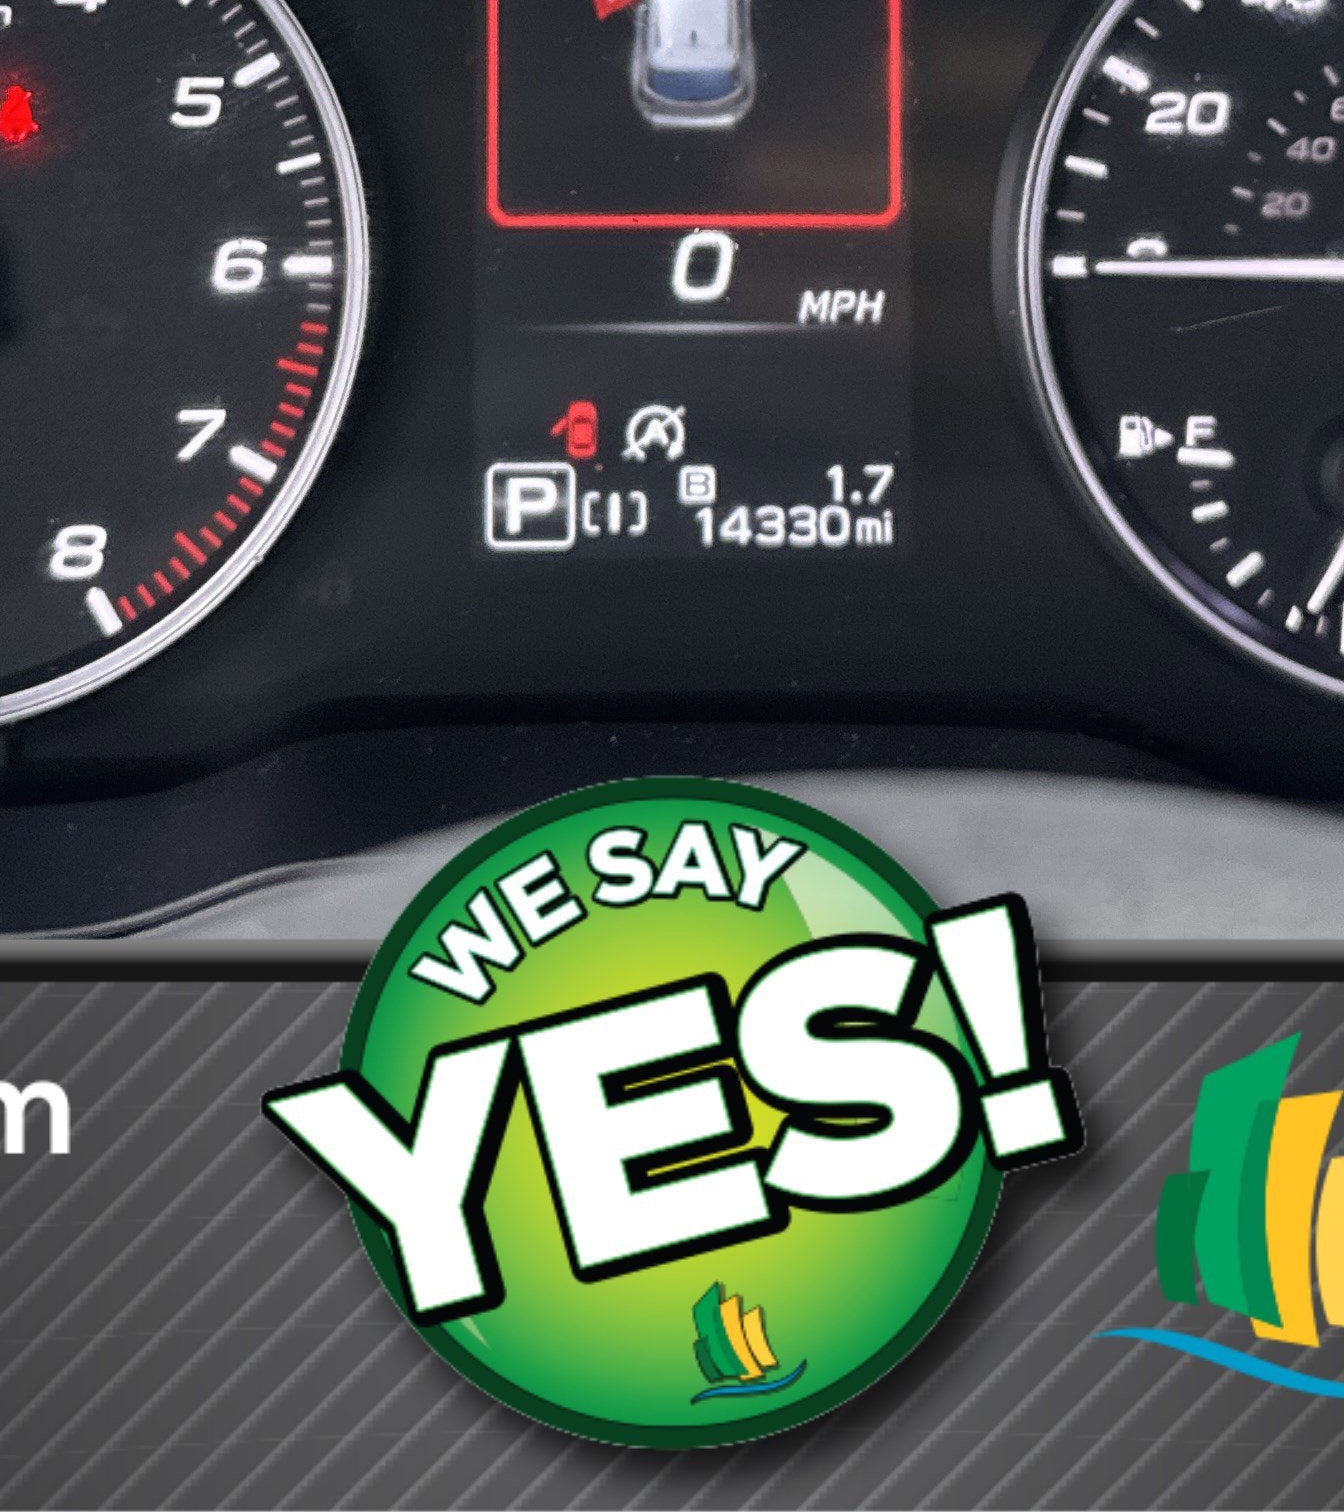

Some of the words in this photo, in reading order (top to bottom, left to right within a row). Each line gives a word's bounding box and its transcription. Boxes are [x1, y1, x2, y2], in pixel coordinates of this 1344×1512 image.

[170, 77, 224, 128] 5
[1145, 91, 1230, 135] 20
[1286, 137, 1337, 162] 40
[1262, 193, 1310, 218] 20
[213, 239, 267, 293] 6
[673, 231, 733, 301] 0
[799, 291, 885, 324] MPH
[177, 409, 225, 461] 7
[1186, 416, 1217, 446] F
[506, 478, 556, 535] P
[827, 465, 894, 503] 1.7
[49, 525, 106, 579] 8
